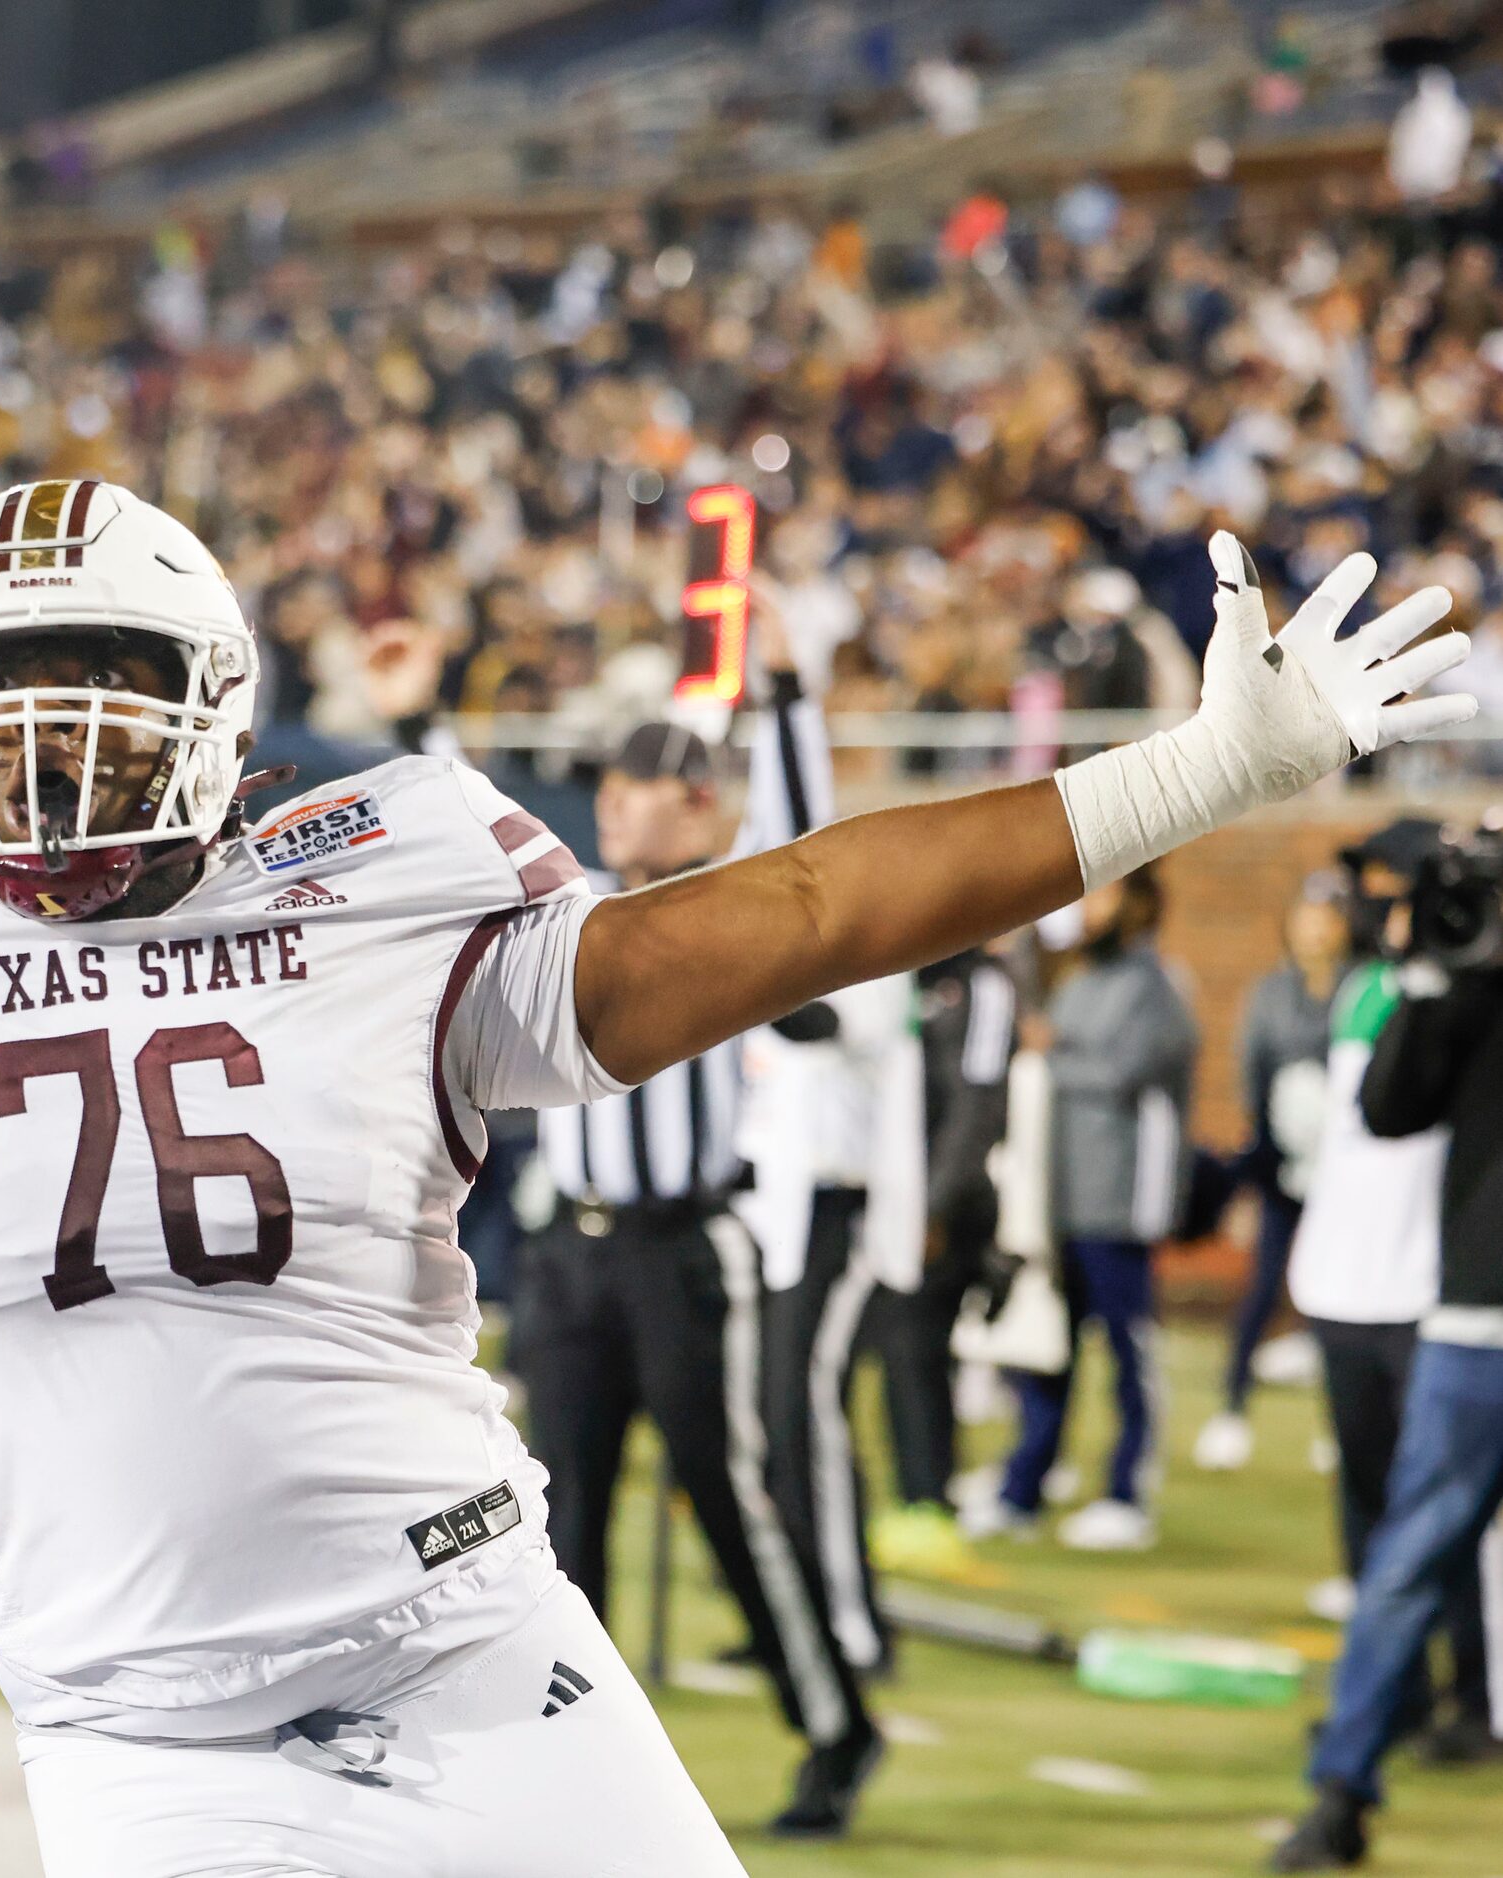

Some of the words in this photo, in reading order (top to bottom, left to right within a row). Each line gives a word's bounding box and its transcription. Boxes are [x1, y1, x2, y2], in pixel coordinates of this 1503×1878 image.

[674, 484, 755, 706] 3
[254, 798, 371, 855] F1RST
[262, 816, 382, 864] RESPONDER
[305, 842, 348, 861] BOWL
[265, 894, 348, 911] adidas
[138, 923, 307, 998] STATE
[459, 1519, 482, 1541] 2XL
[422, 1538, 455, 1560] adidas
